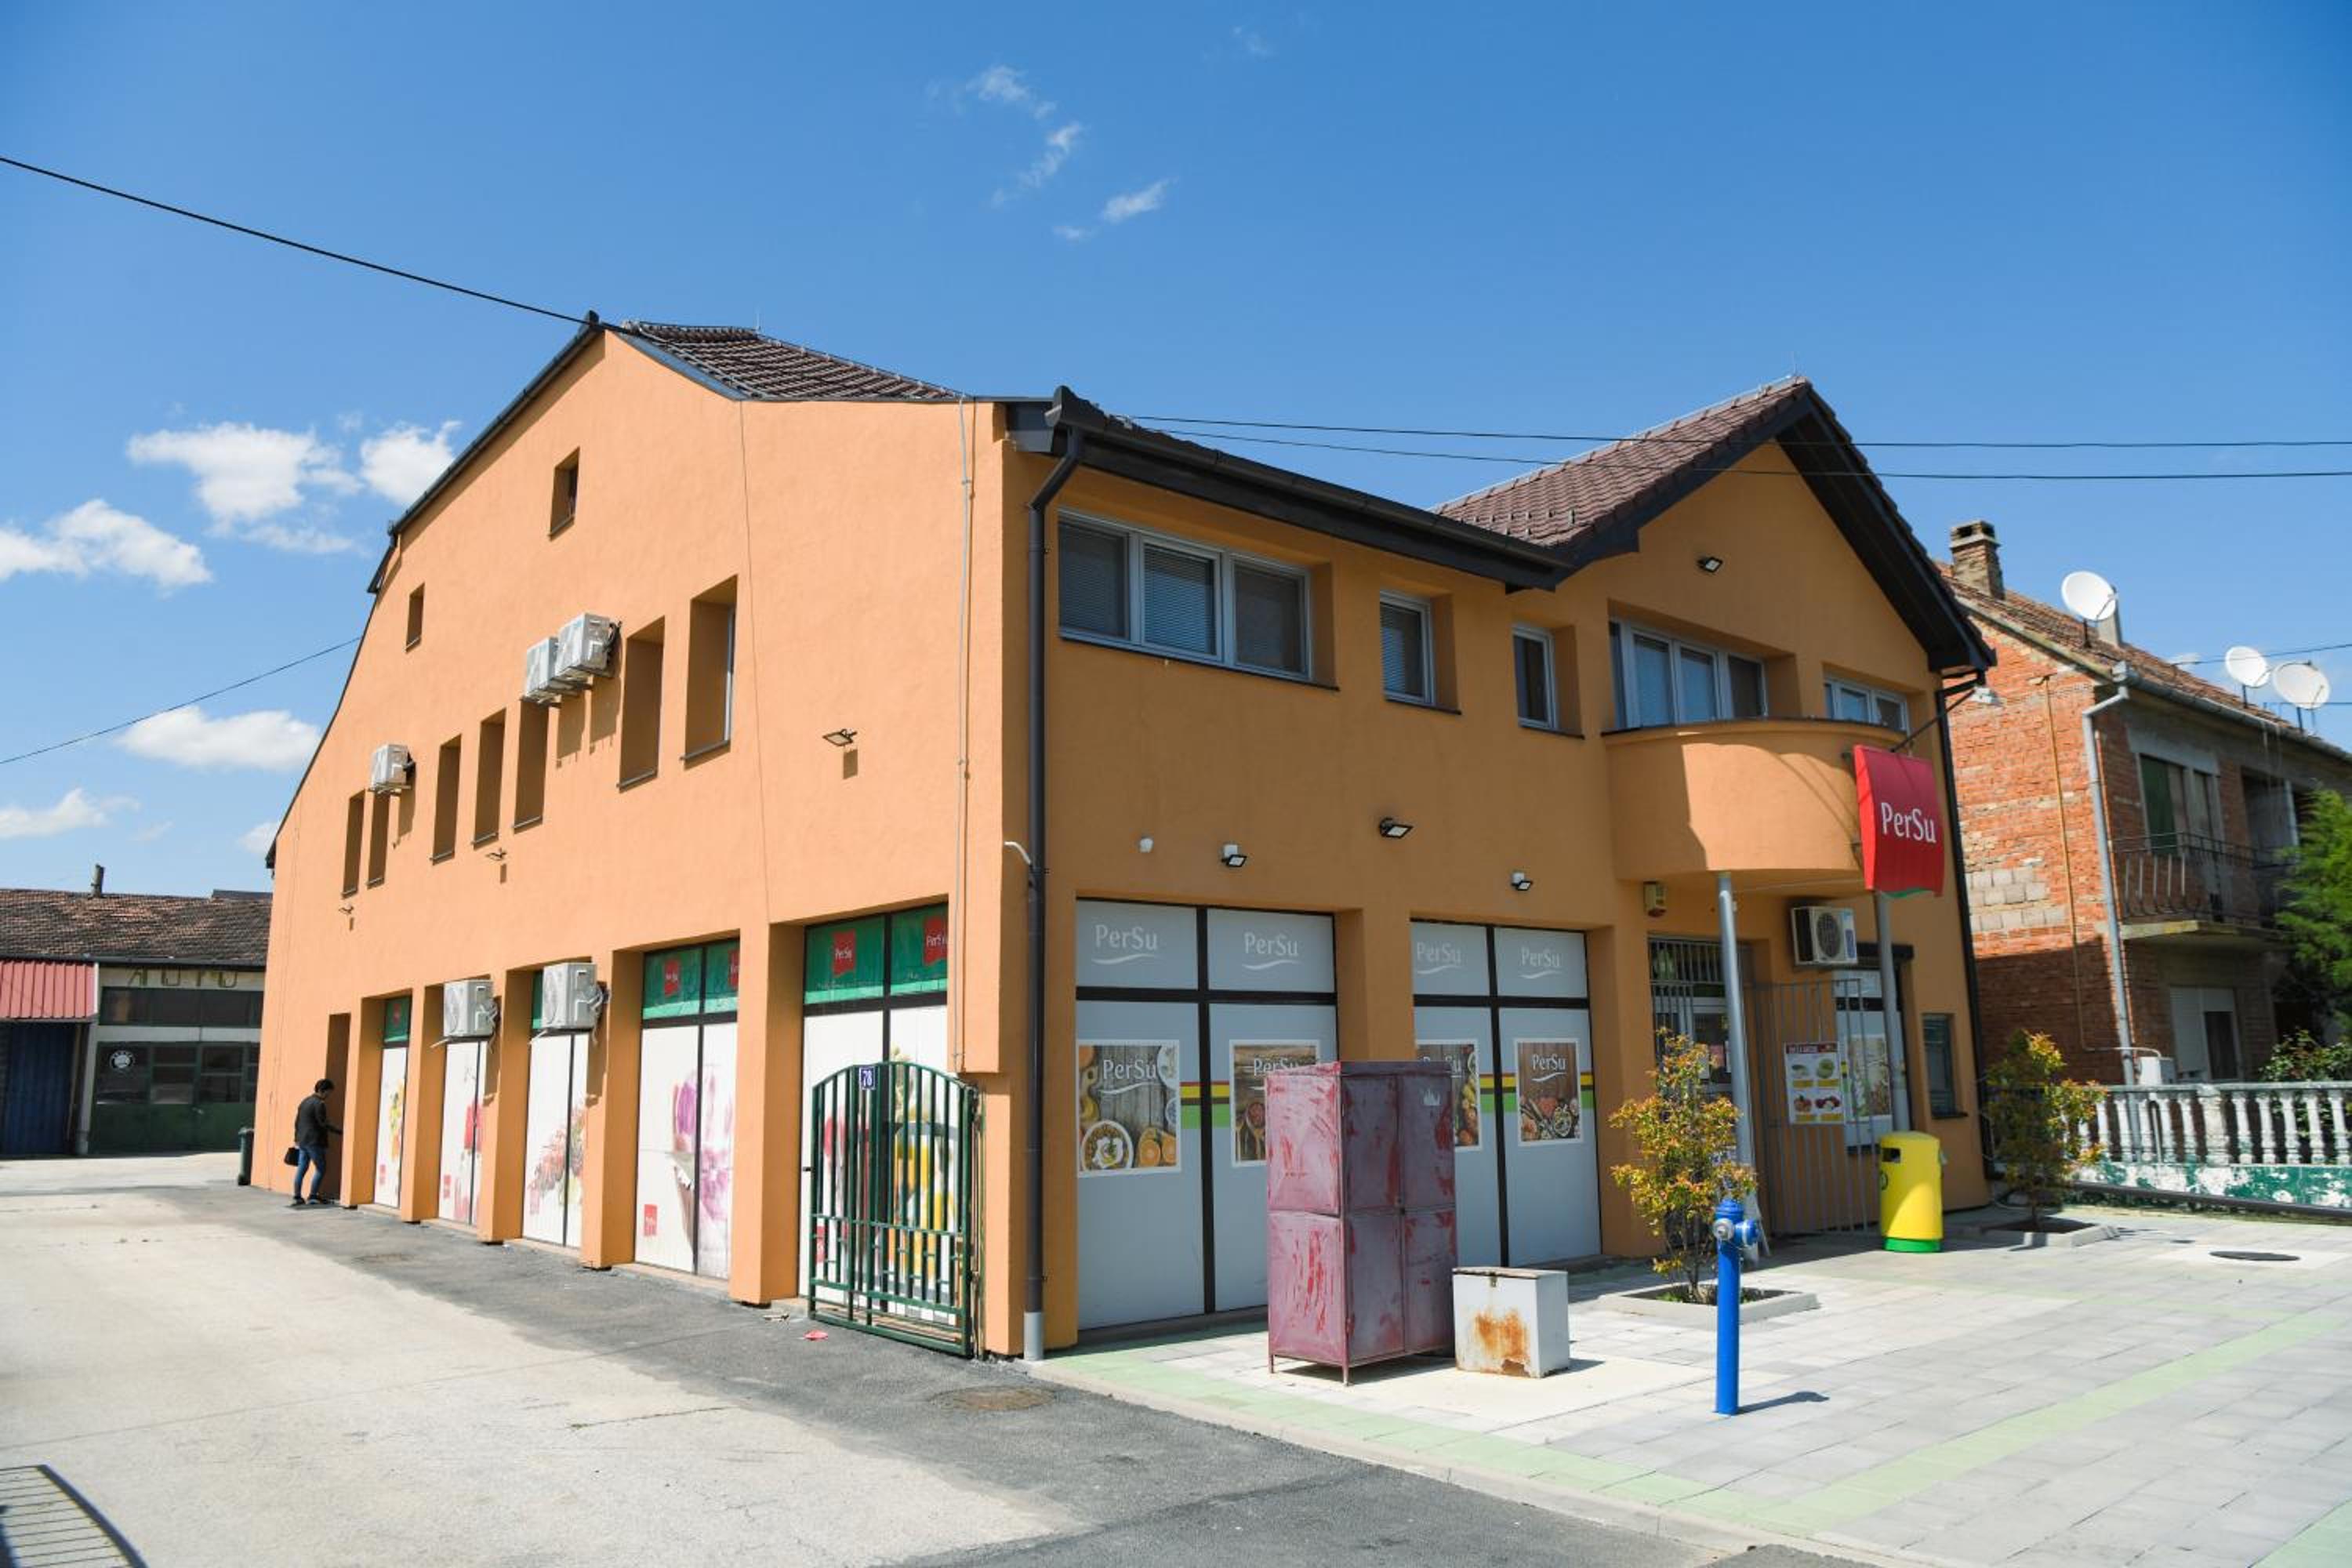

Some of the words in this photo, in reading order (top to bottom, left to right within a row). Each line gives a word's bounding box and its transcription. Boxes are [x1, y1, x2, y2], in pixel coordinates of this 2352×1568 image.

[1881, 802, 1936, 844] PerSu
[1094, 924, 1158, 950] PerSu
[1243, 931, 1299, 956] PerSu
[1417, 941, 1462, 964] PerSu
[1520, 946, 1560, 967] PerSu
[1103, 1058, 1157, 1080] PerSu
[1532, 1053, 1566, 1071] PerSu
[862, 1070, 873, 1087] 78
